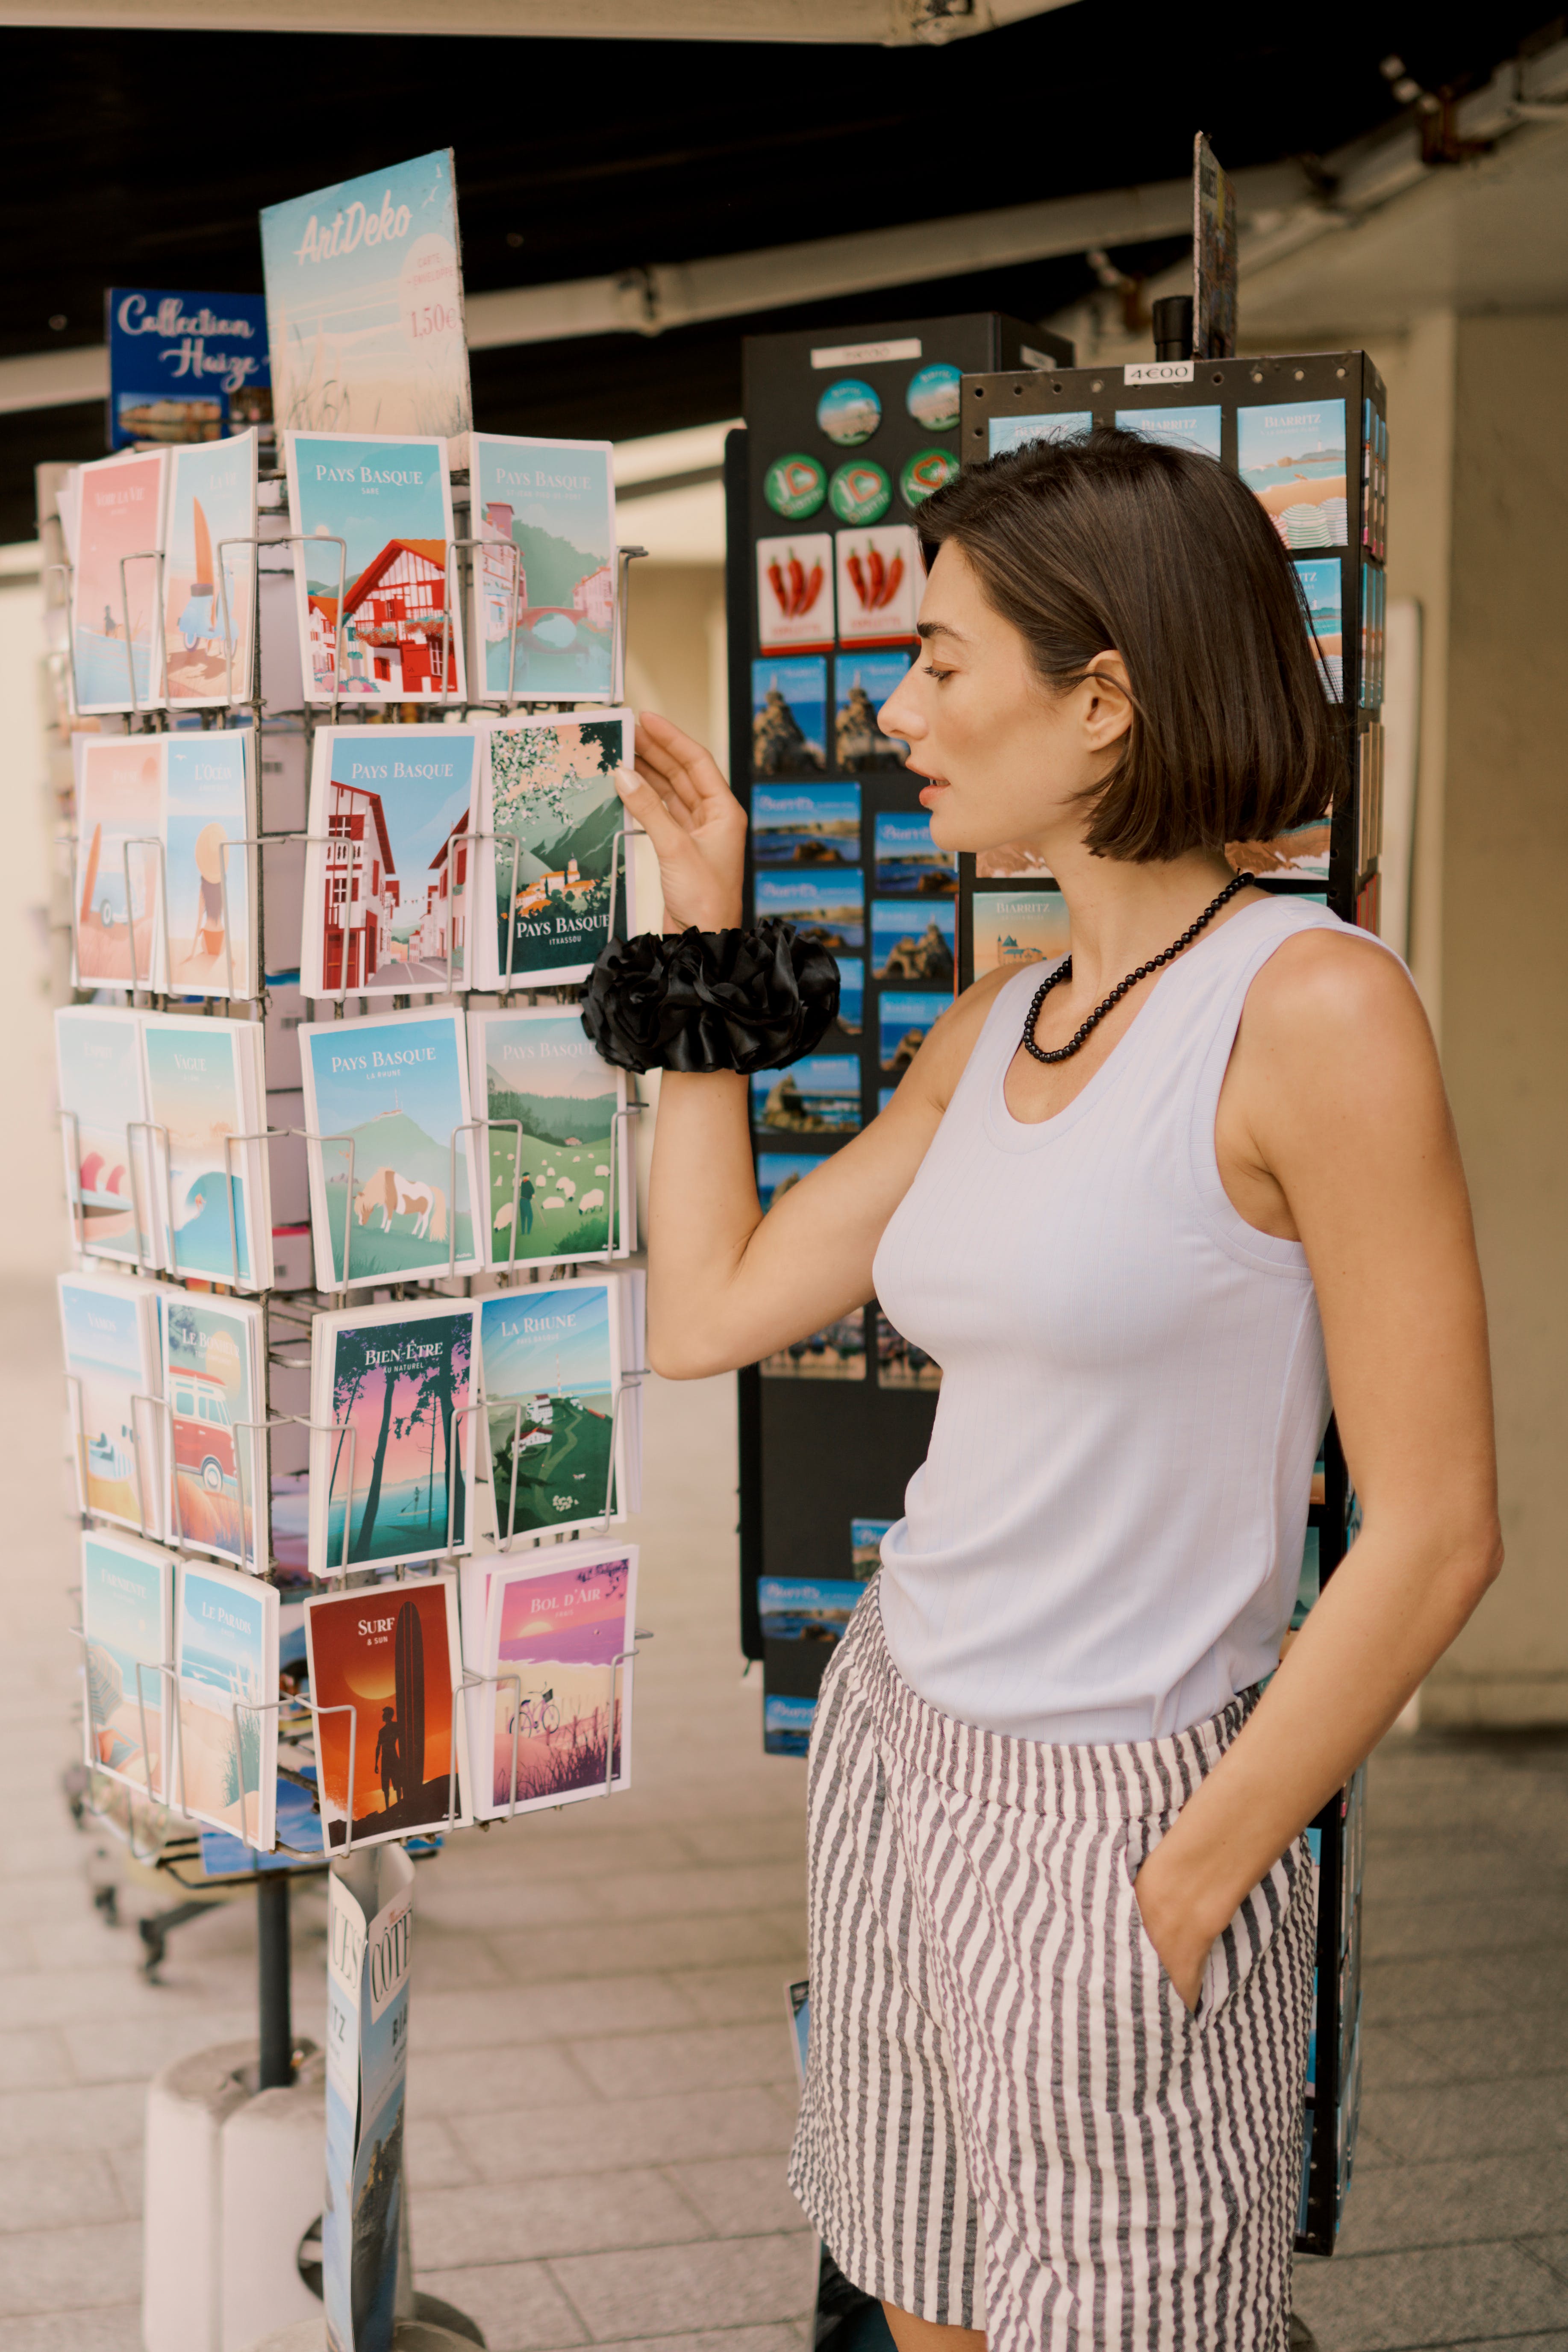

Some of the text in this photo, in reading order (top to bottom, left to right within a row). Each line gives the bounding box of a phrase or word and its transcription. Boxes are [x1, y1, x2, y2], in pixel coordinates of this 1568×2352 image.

[118, 294, 255, 339] Collection
[411, 304, 457, 339] 1,50€
[1131, 367, 1188, 379] 4€00
[1265, 414, 1321, 428] BIARRITZ
[316, 465, 424, 486] PAYS BASQUE
[496, 468, 591, 491] PAYS BASQUE
[351, 762, 453, 779] PAYS BASQUE
[997, 902, 1050, 913] BIARRITZ
[516, 914, 610, 939] PAYS BASQUE
[332, 1047, 436, 1073] PAYS BASQUE
[503, 1042, 596, 1060] PAYS BASQUE
[174, 1054, 207, 1072] VAGUE
[377, 1069, 401, 1078] RHUNE
[501, 1313, 577, 1338] LA RHUNE
[182, 1328, 240, 1359] LE BONHEUR
[365, 1340, 444, 1367] BIEN-ÊTRE
[383, 1361, 424, 1374] AU NATUREL
[530, 1588, 601, 1614] BOL D'AIR
[201, 1601, 251, 1636] LE PARADIS
[357, 1617, 396, 1637] SURF
[367, 1635, 388, 1646] & SUN
